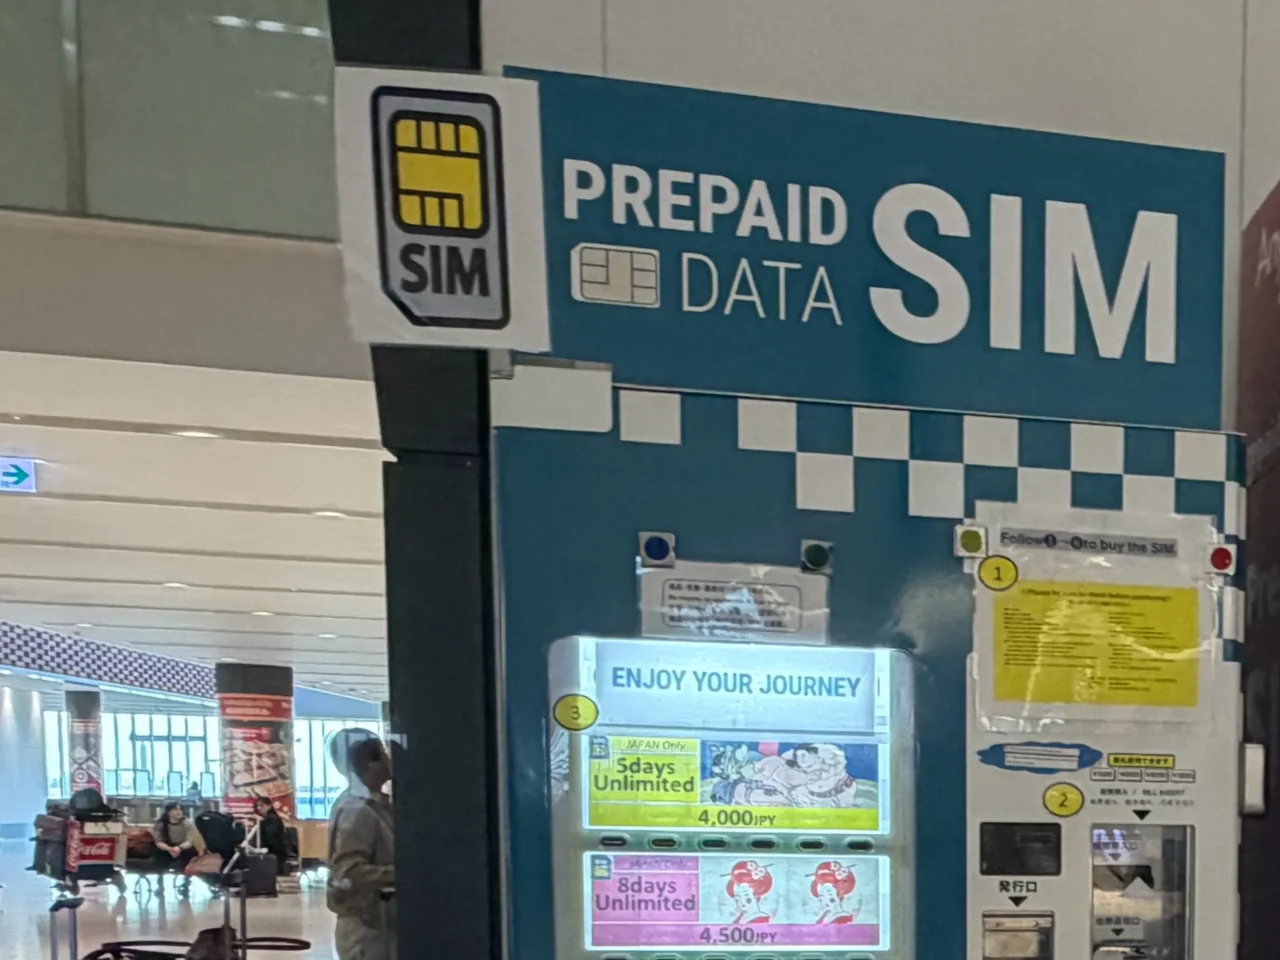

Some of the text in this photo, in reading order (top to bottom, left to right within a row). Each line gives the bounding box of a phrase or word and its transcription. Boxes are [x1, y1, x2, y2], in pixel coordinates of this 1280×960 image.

[562, 158, 848, 246] PREPAID
[399, 243, 491, 299] SIM
[868, 181, 1179, 366] SIM
[681, 253, 844, 327] DATA
[1101, 538, 1124, 554] buy
[1127, 540, 1147, 554] the
[612, 666, 862, 698] ENJOY YOUR JOURNEY
[570, 705, 581, 720] 3
[616, 756, 676, 777] 5days
[593, 774, 695, 794] Unlimited
[1058, 792, 1068, 807] 2
[617, 876, 677, 896] 8days
[998, 881, 1038, 893] 発行口
[594, 893, 696, 914] Unlimited
